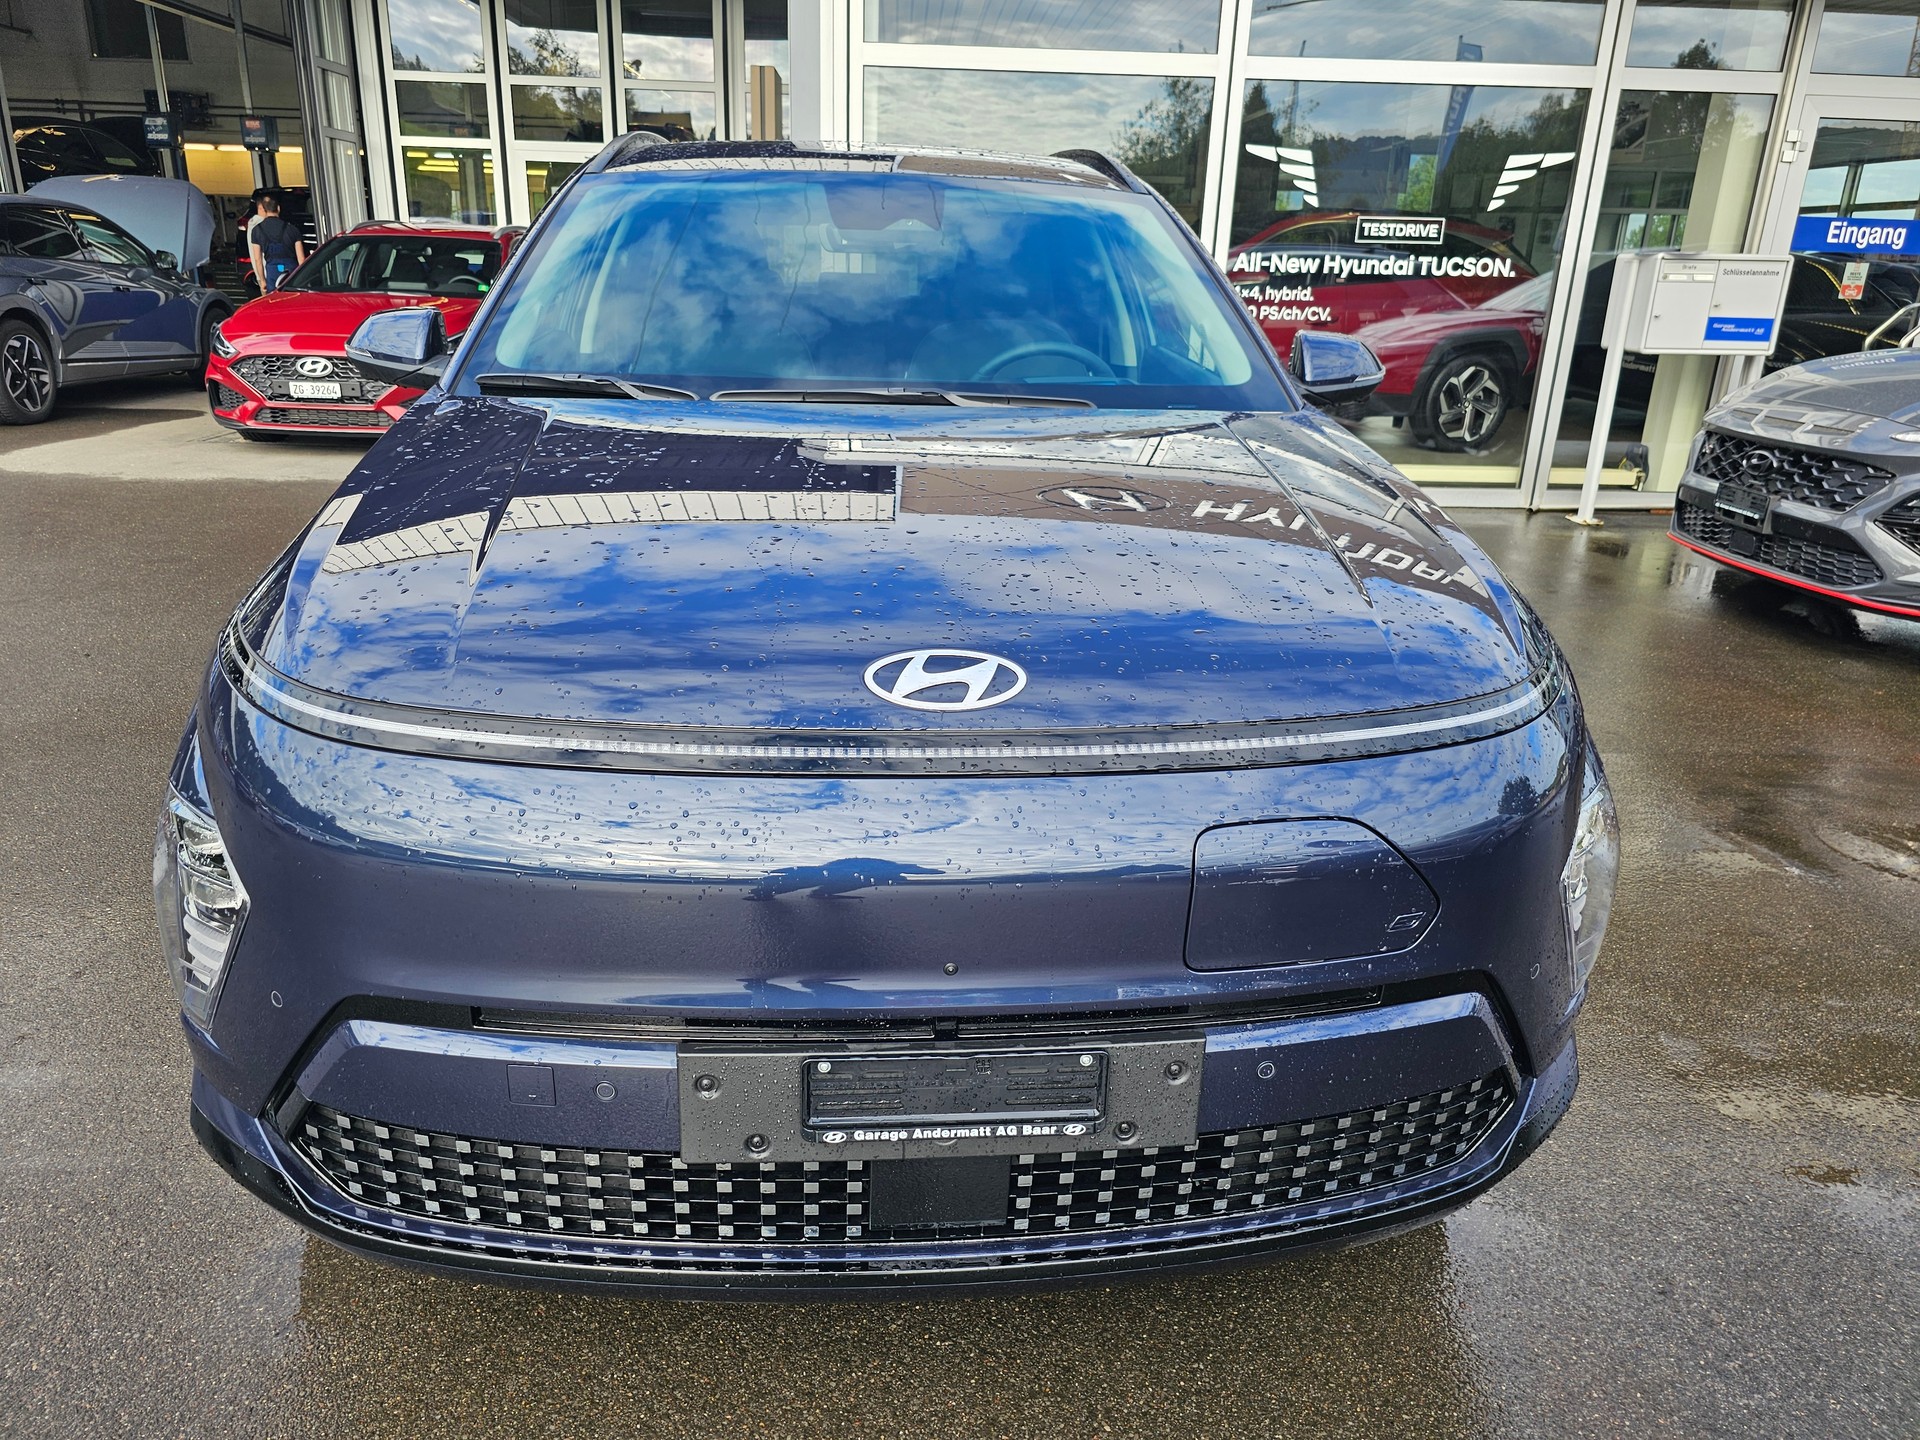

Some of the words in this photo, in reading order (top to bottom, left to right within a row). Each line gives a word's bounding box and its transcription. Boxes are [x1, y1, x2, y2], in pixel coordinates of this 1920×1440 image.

[1362, 222, 1440, 238] TESTDRIVE
[1826, 221, 1907, 250] Eingang
[1232, 252, 1319, 274] All-New
[1323, 254, 1415, 278] Hyundai
[1418, 256, 1516, 278] TUCSON.
[1722, 268, 1780, 276] Schlüsselannahme
[1265, 285, 1315, 303] hybrid.
[1259, 306, 1332, 322] PS/ch/CV.
[854, 1129, 908, 1141] Garage
[912, 1125, 991, 1139] Andermatt
[996, 1125, 1017, 1136] AG
[1023, 1124, 1057, 1136] Baar
